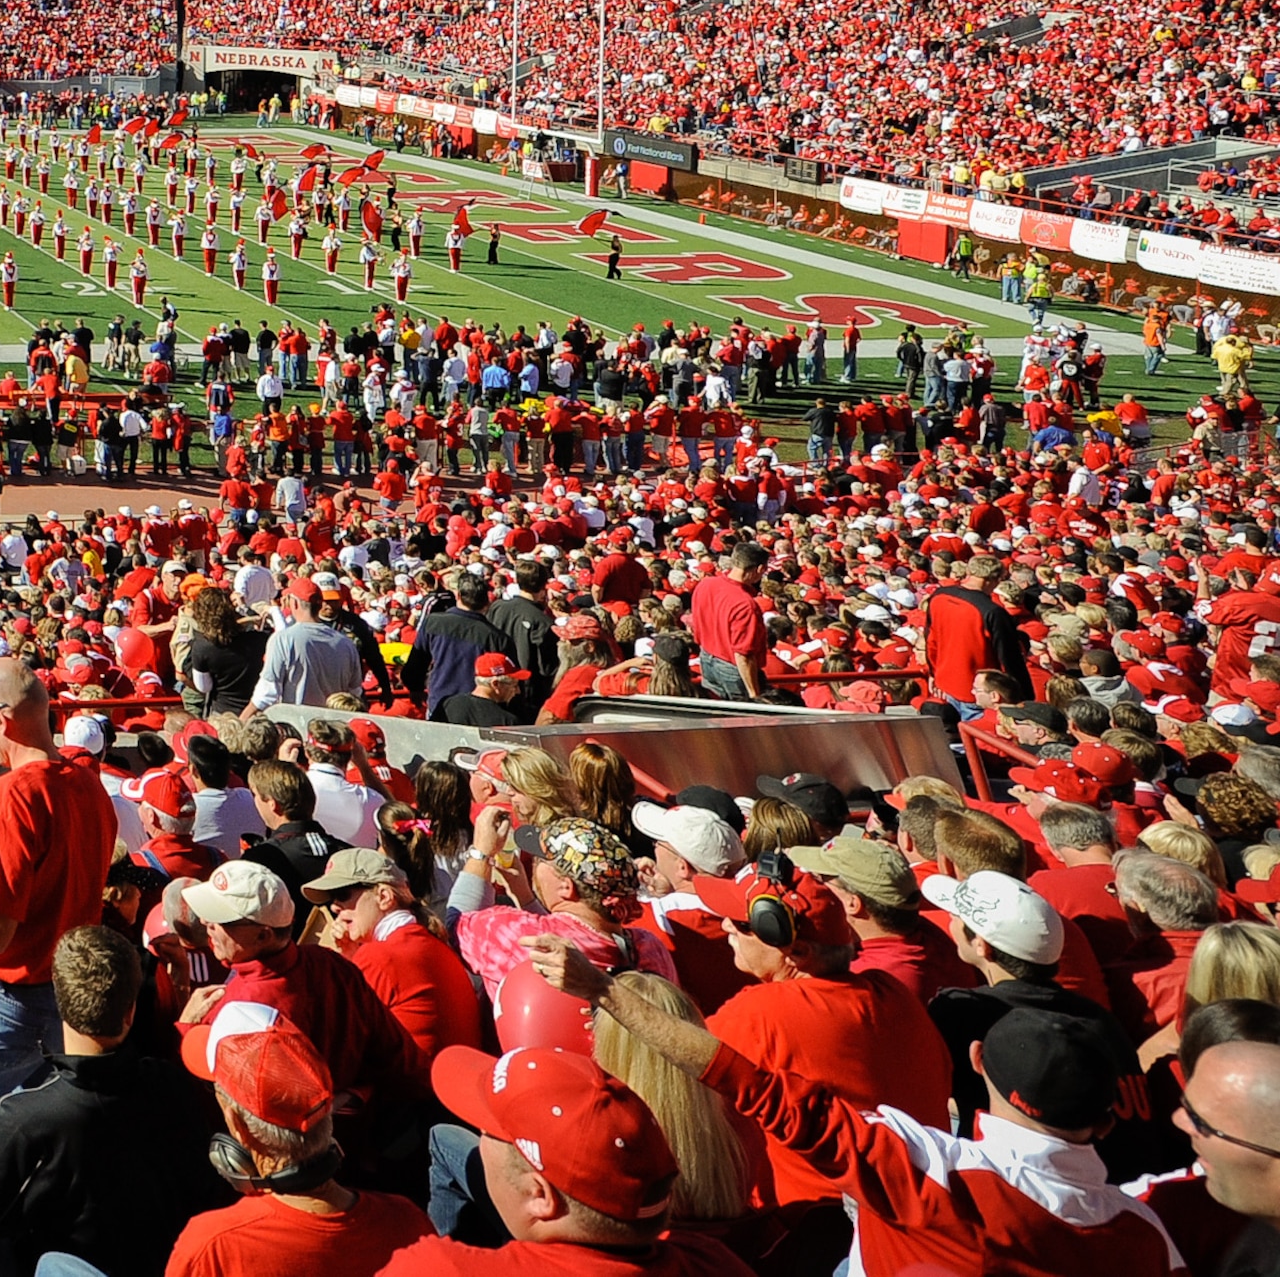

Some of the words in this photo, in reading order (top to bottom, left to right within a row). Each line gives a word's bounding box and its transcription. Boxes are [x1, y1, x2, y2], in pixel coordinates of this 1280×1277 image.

[190, 51, 201, 62] N
[215, 52, 307, 70] NEBRASKA
[322, 58, 334, 70] N
